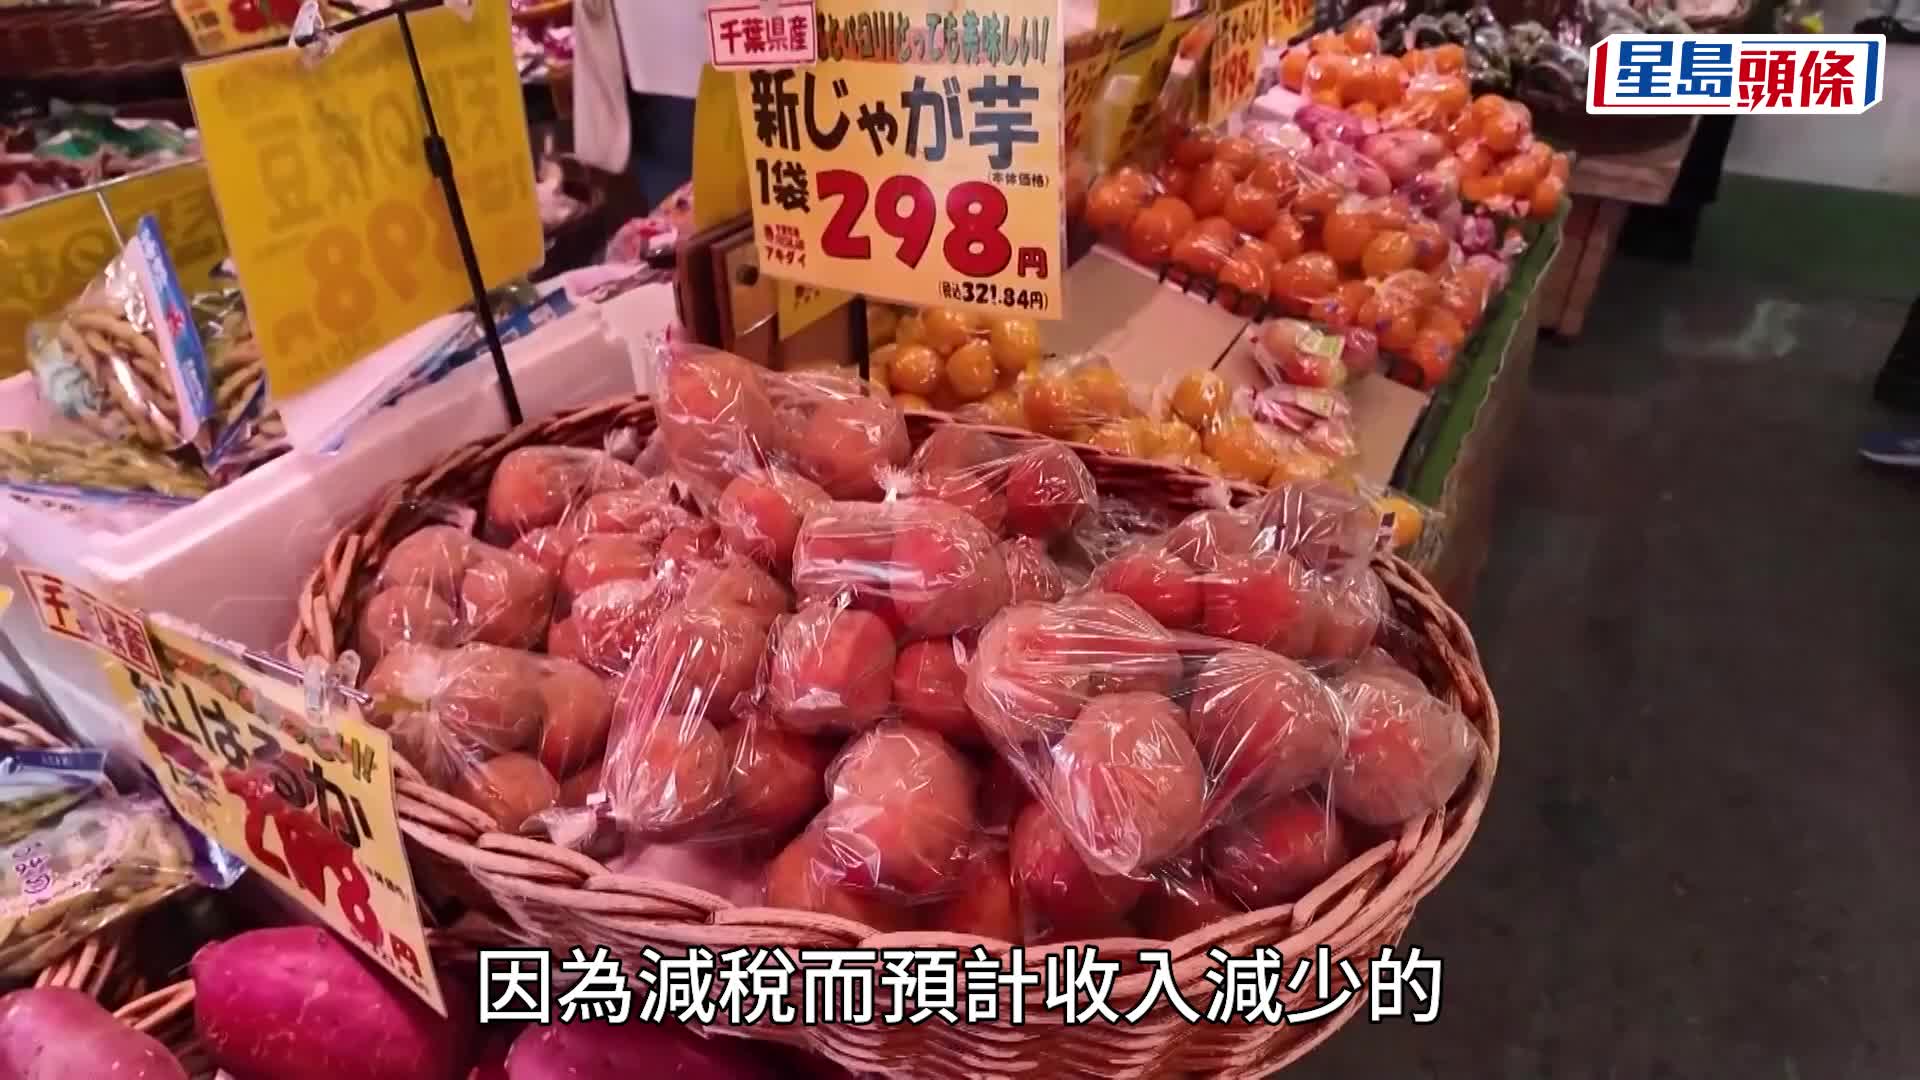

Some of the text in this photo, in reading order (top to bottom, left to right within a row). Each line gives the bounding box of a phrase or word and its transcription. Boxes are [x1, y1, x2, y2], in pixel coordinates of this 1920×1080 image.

[719, 15, 809, 54] 千葉県産
[748, 69, 1040, 170] 新じゃが芋
[755, 158, 1048, 280] 1袋 298円
